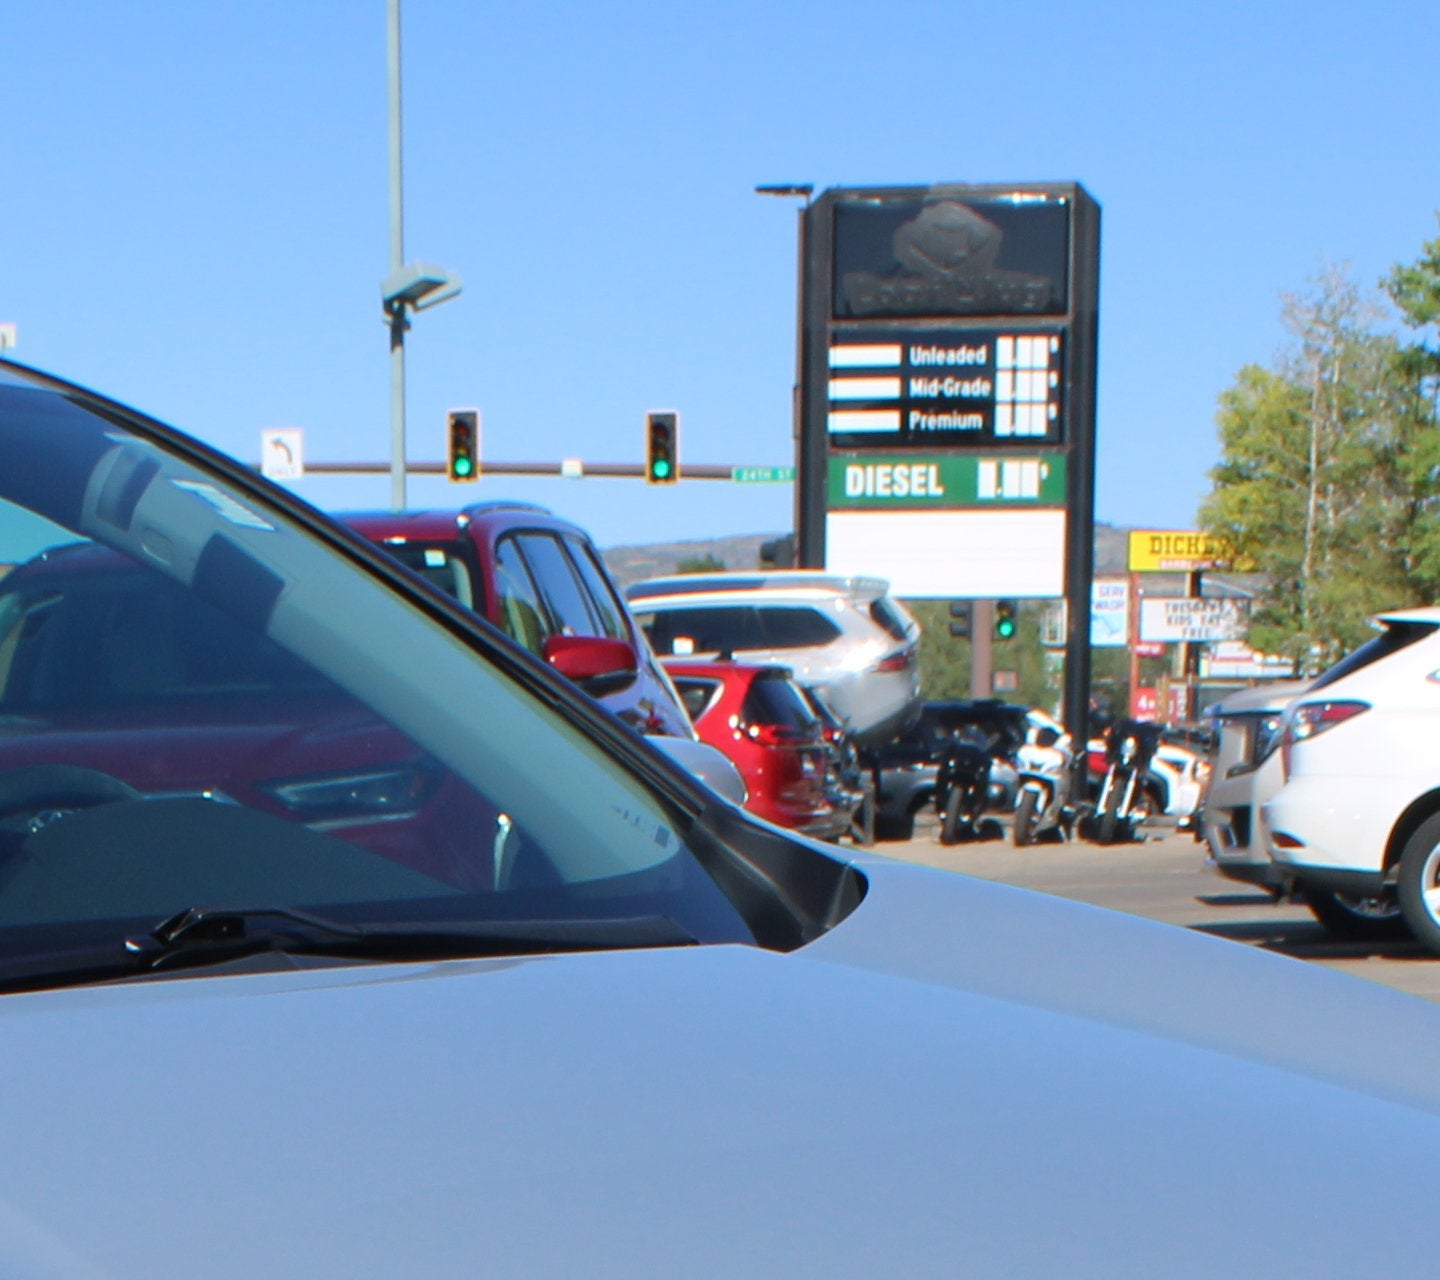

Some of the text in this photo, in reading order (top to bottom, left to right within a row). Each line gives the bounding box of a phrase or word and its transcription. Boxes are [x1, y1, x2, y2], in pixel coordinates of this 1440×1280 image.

[909, 344, 987, 367] Unleaded
[909, 376, 993, 399] Mid-Grade
[908, 410, 984, 431] Premium
[845, 463, 945, 498] DIESEL
